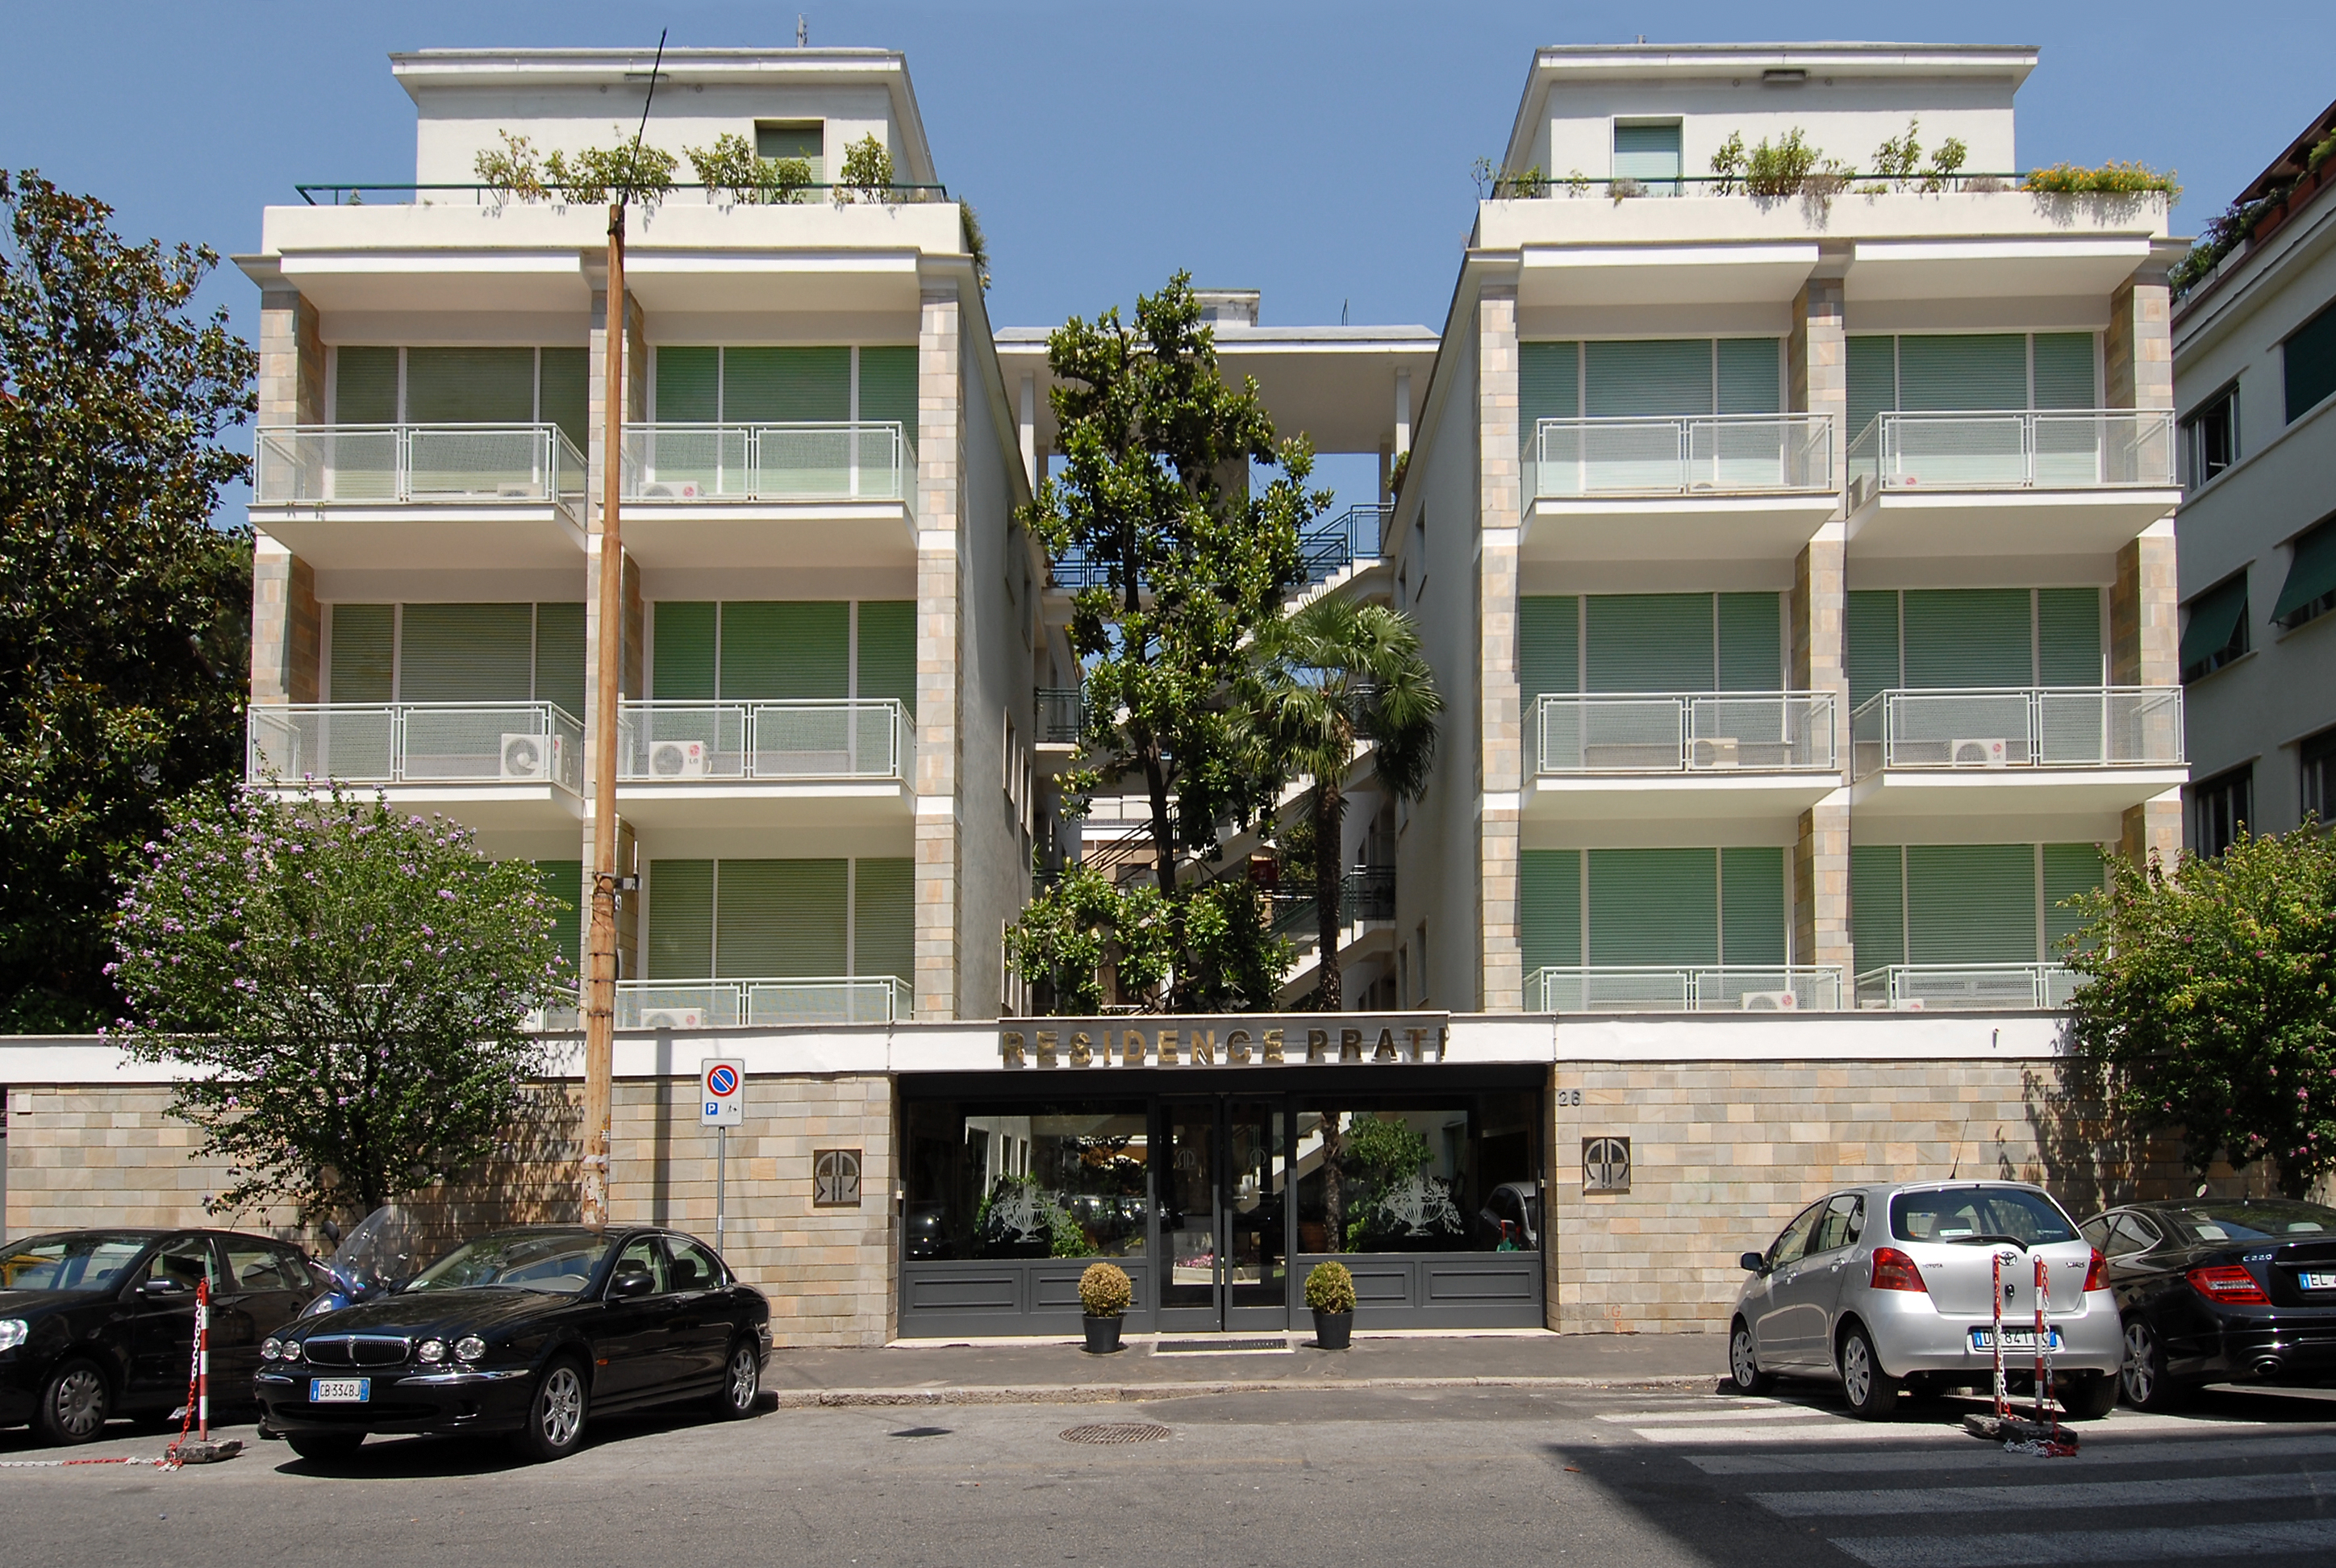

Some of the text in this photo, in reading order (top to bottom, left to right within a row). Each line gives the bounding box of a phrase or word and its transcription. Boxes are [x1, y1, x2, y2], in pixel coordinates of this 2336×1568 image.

[1003, 1027, 1447, 1064] RESIDENCE PRATI
[1558, 1089, 1581, 1106] 26
[707, 1103, 716, 1114] P
